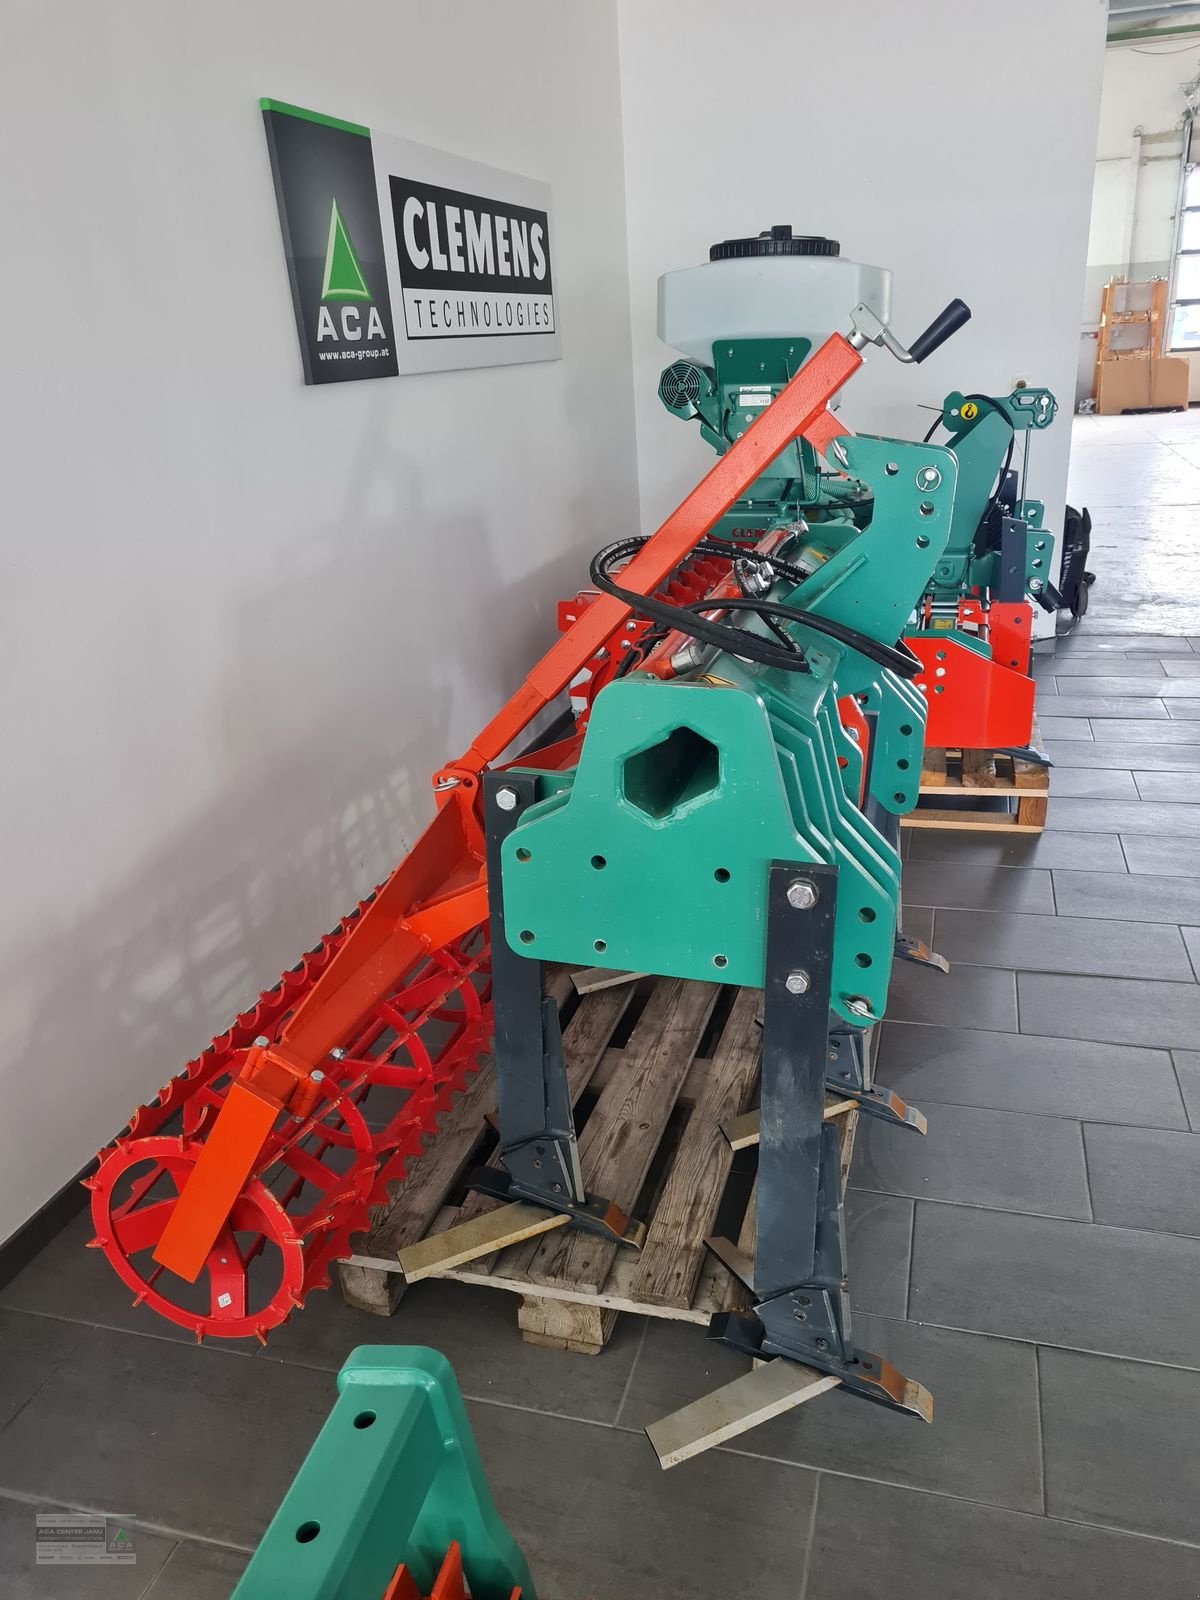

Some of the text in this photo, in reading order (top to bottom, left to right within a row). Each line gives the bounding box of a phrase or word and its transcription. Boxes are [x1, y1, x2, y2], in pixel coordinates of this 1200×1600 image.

[403, 196, 546, 281] CLEMENS
[317, 305, 386, 341] ACA
[414, 300, 549, 328] TECHNOLOGIES
[319, 348, 389, 361] www.aca-group.at
